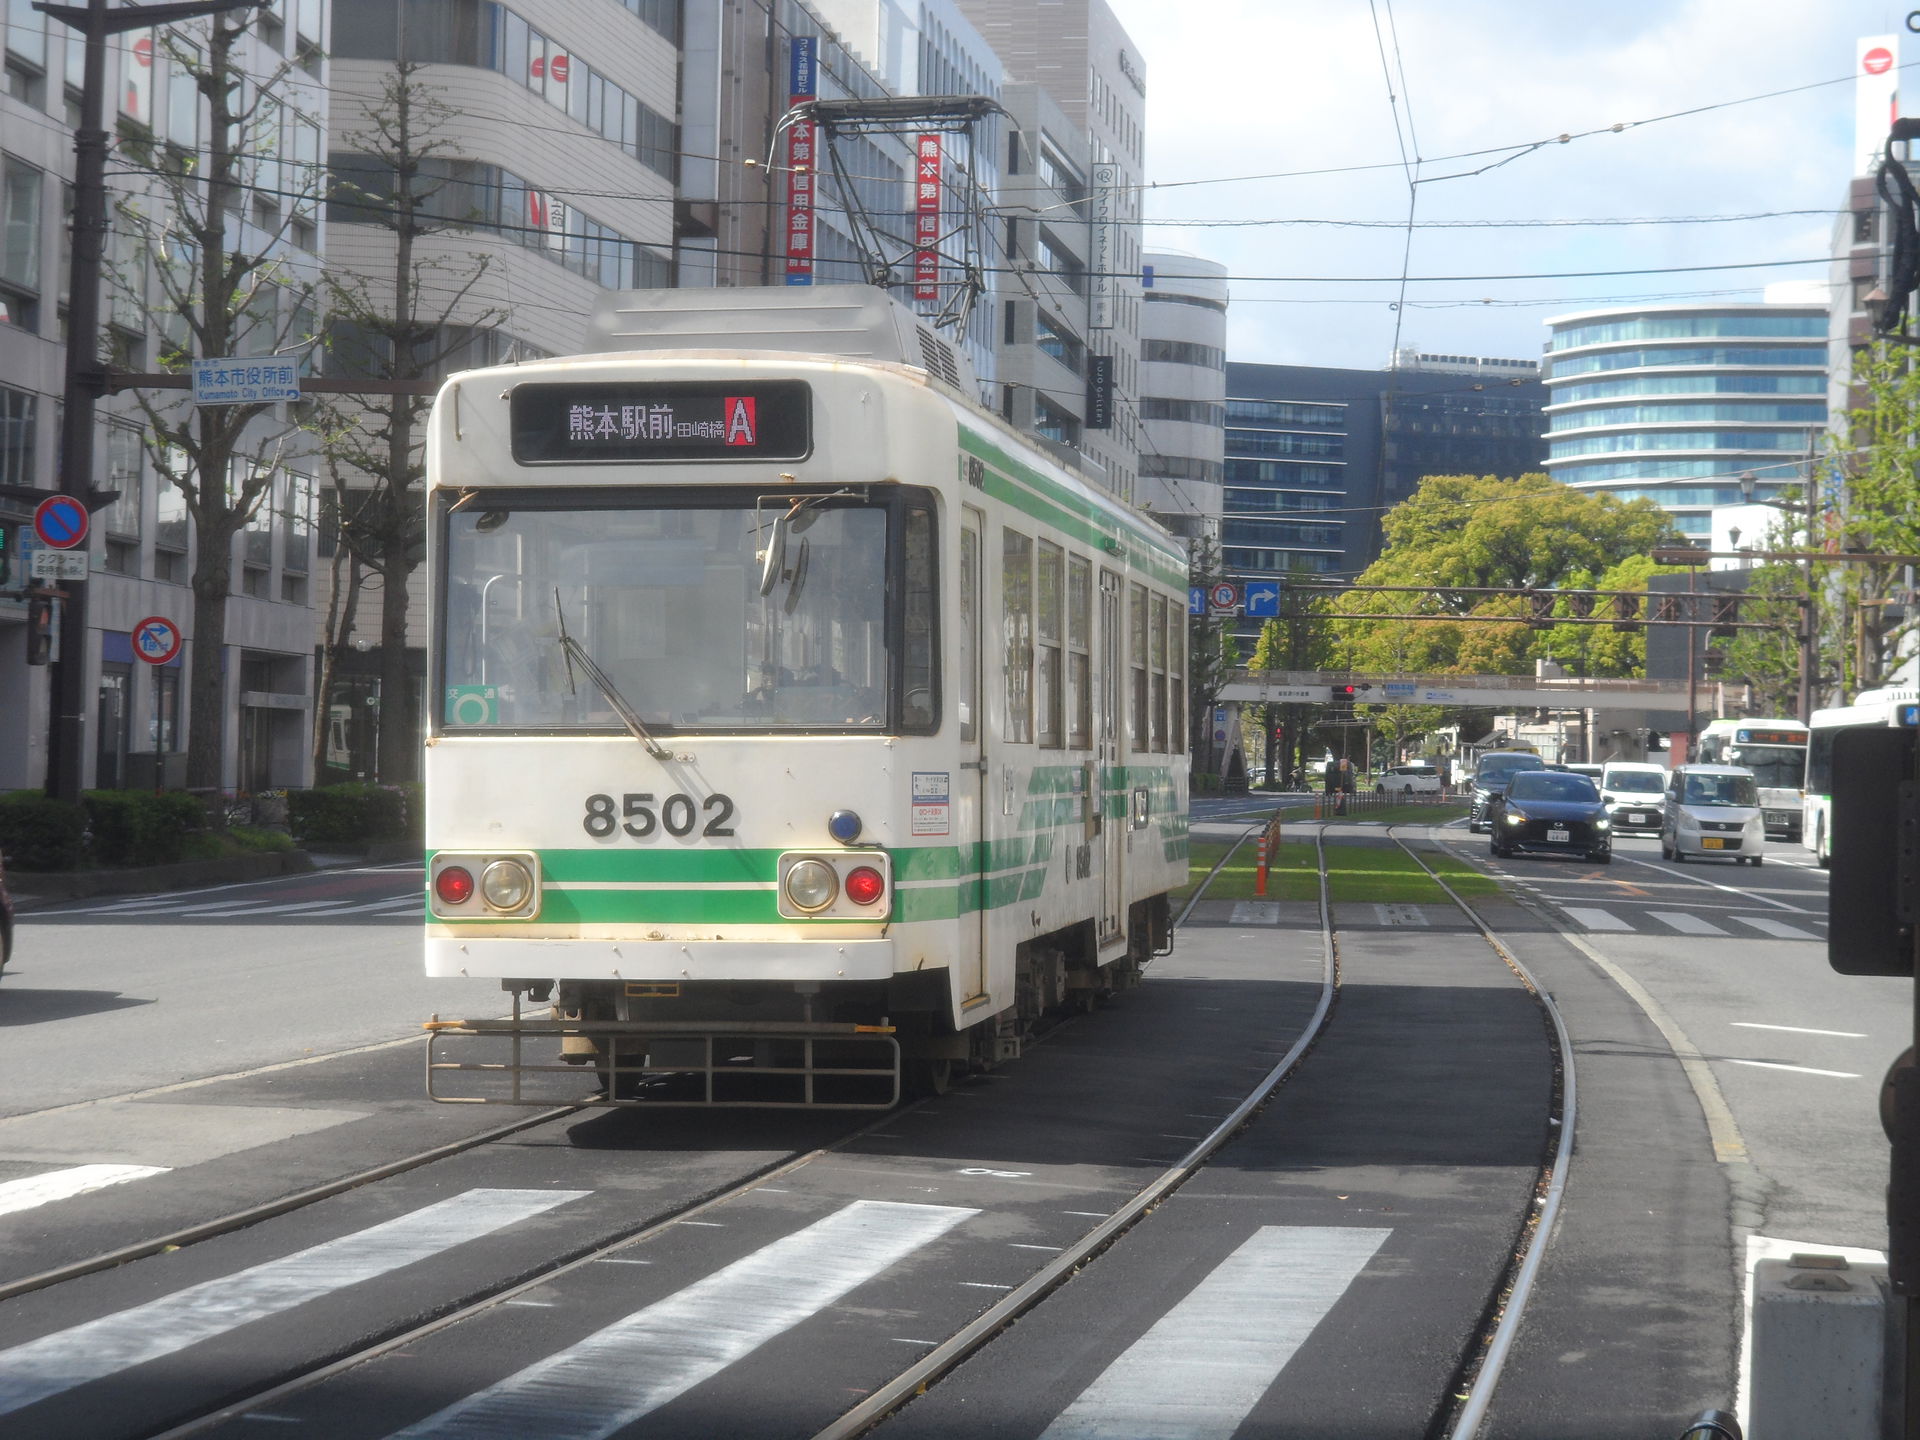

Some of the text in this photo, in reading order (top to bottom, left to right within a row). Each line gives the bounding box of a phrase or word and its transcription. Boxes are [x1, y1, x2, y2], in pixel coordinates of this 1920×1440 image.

[198, 366, 293, 388] 熊本市役所前
[199, 386, 285, 400] Kumamoto City Office
[728, 399, 753, 443] A
[969, 455, 985, 491] 8502
[583, 793, 735, 838] 8502
